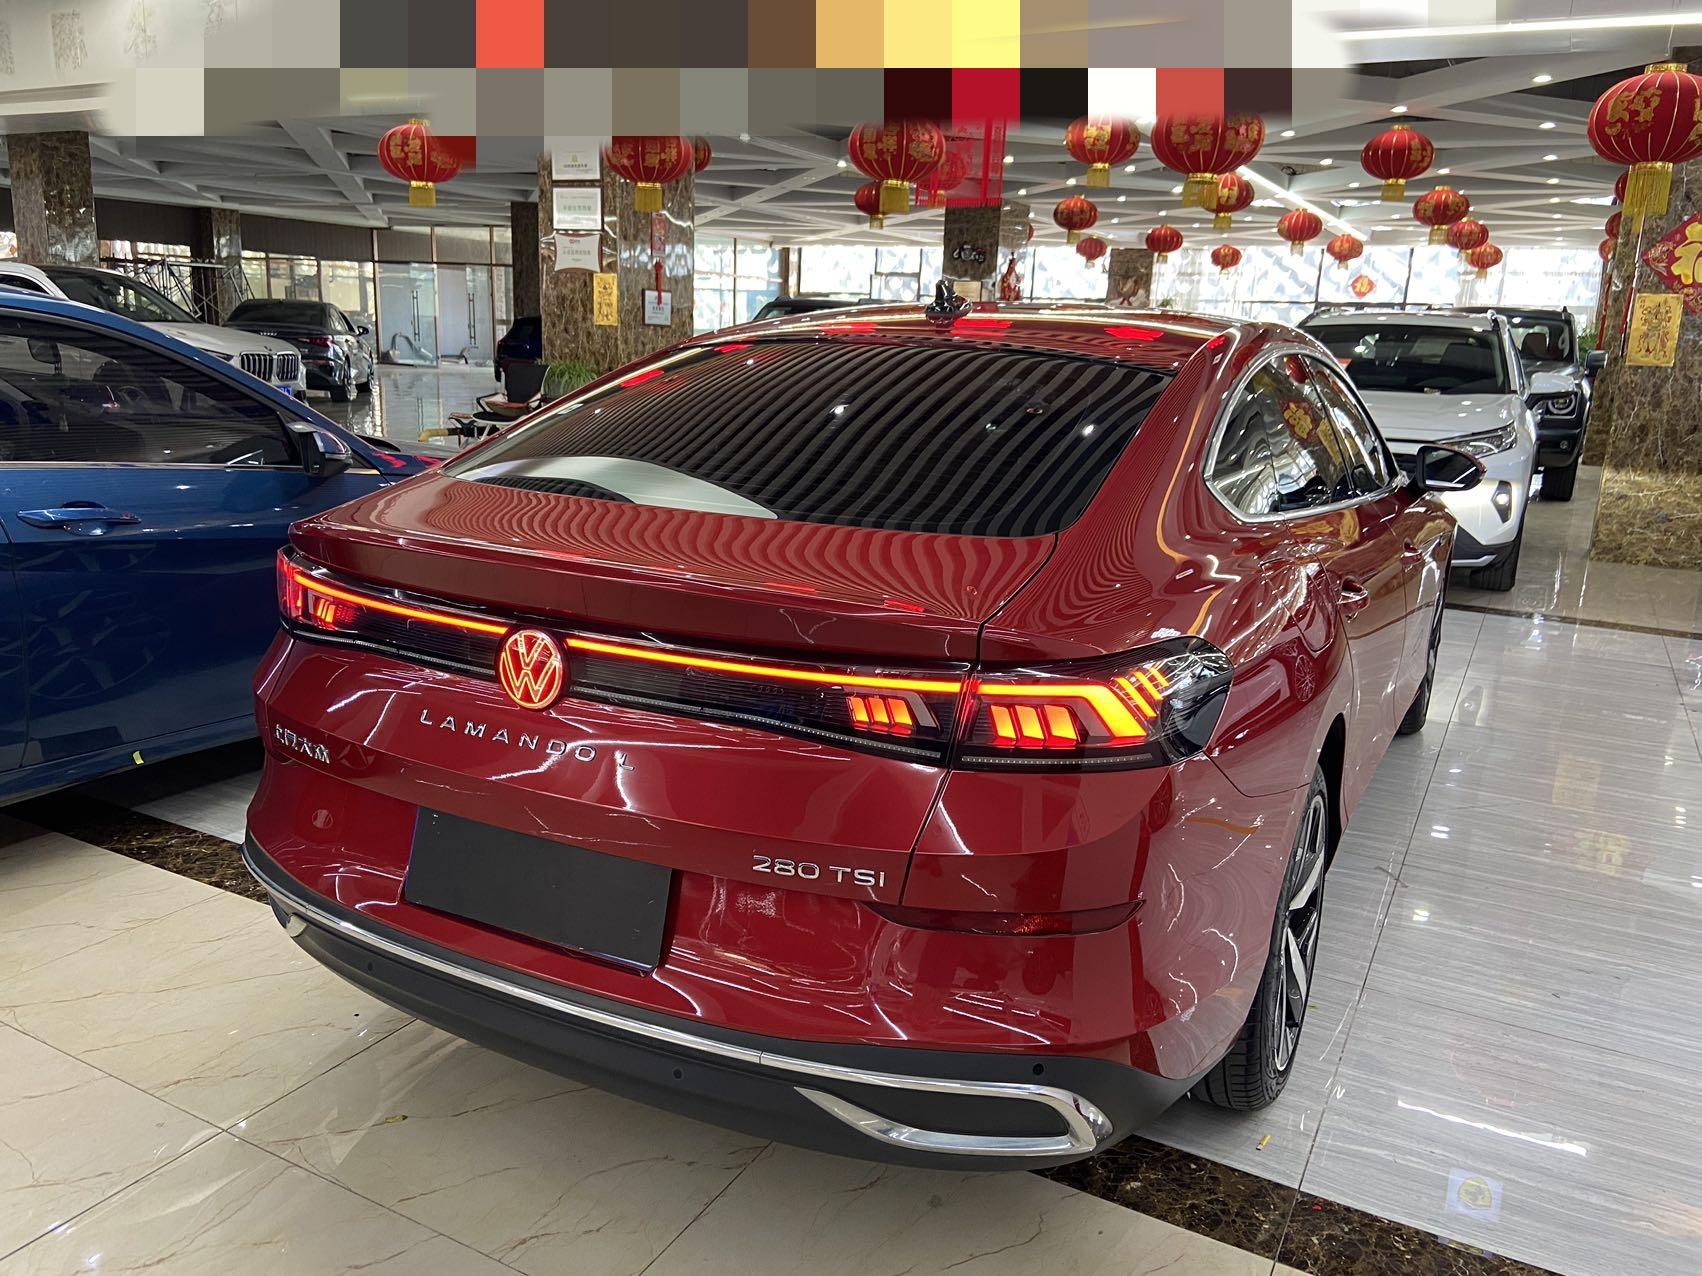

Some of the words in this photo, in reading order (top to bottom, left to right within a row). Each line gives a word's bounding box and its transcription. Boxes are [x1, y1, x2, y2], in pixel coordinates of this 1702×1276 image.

[419, 708, 597, 762] LAMANDO
[617, 753, 635, 771] L
[752, 854, 820, 880] 280
[828, 865, 885, 888] TSI
